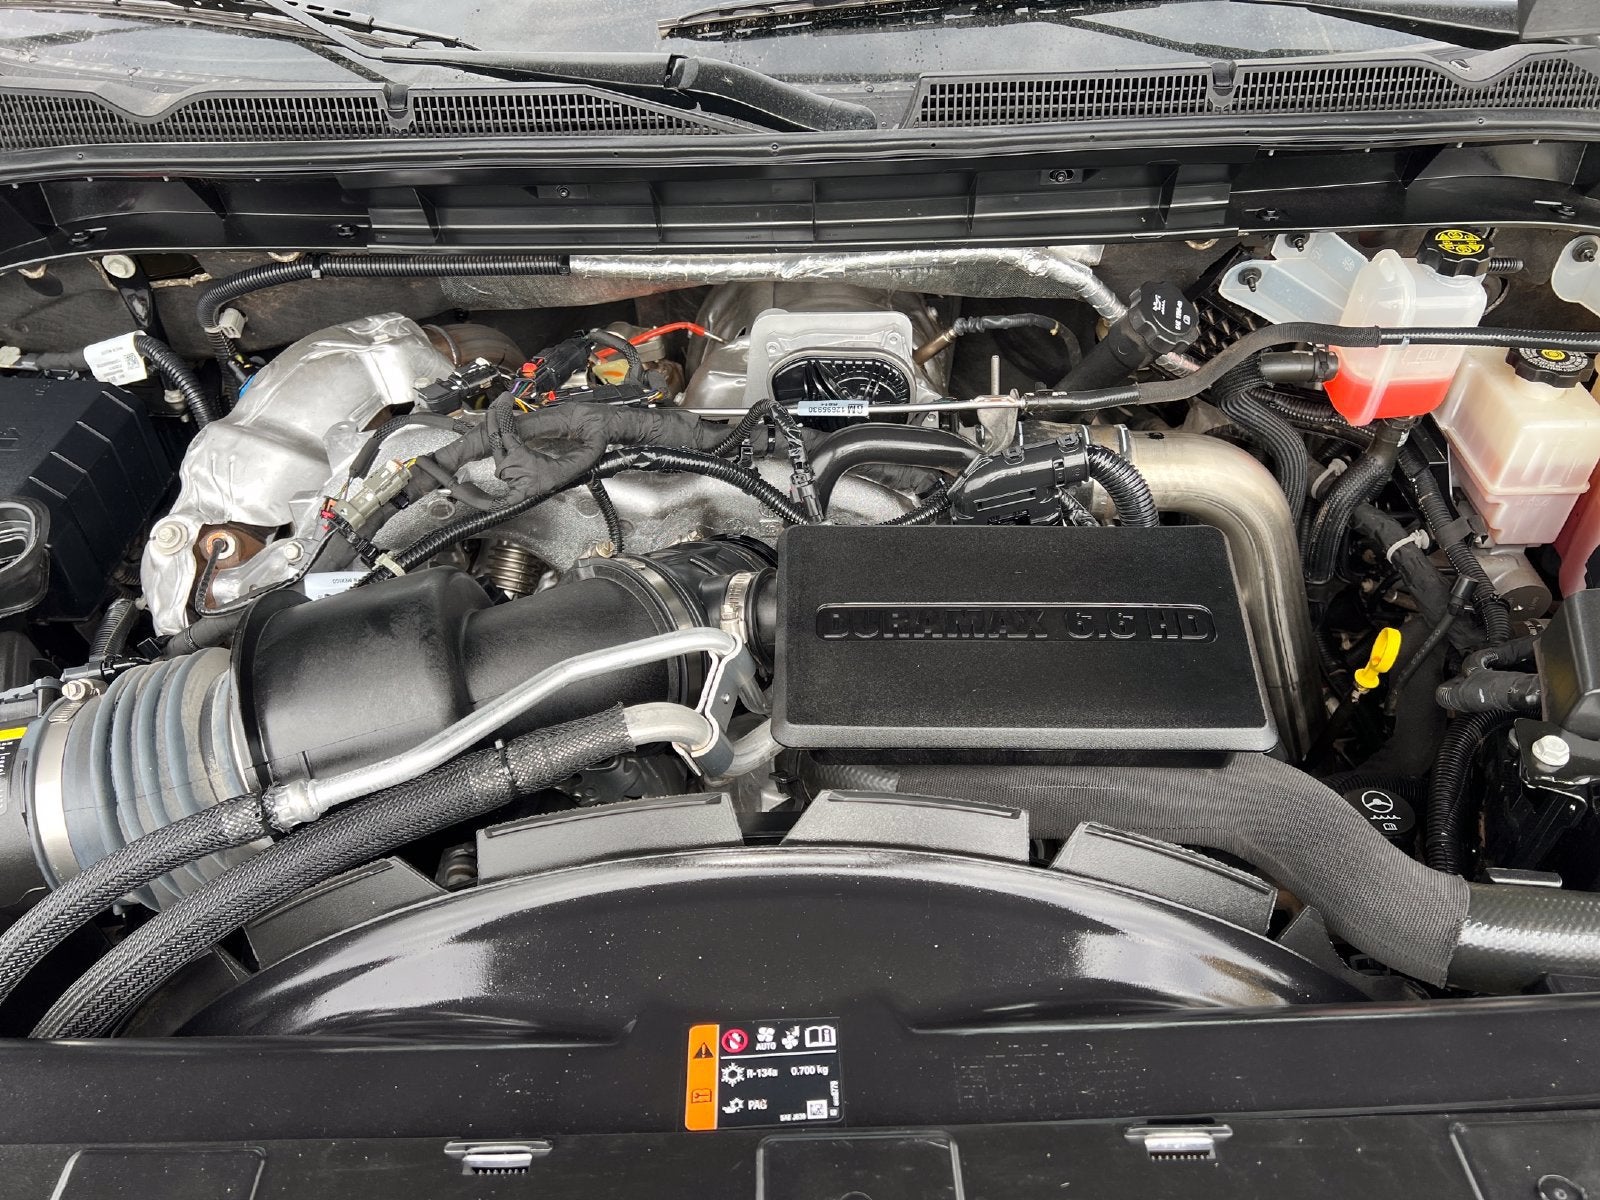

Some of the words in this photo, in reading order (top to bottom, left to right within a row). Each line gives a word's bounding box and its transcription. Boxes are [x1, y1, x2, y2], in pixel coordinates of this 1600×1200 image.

[823, 609, 1048, 639] DURAMAX
[1065, 609, 1137, 639] 6.6
[1146, 610, 1210, 640] HD
[755, 1042, 777, 1051] AUTO
[746, 1068, 778, 1079] R-134a
[790, 1066, 816, 1076] 0.700
[816, 1065, 829, 1076] kg
[747, 1099, 768, 1110] PAG
